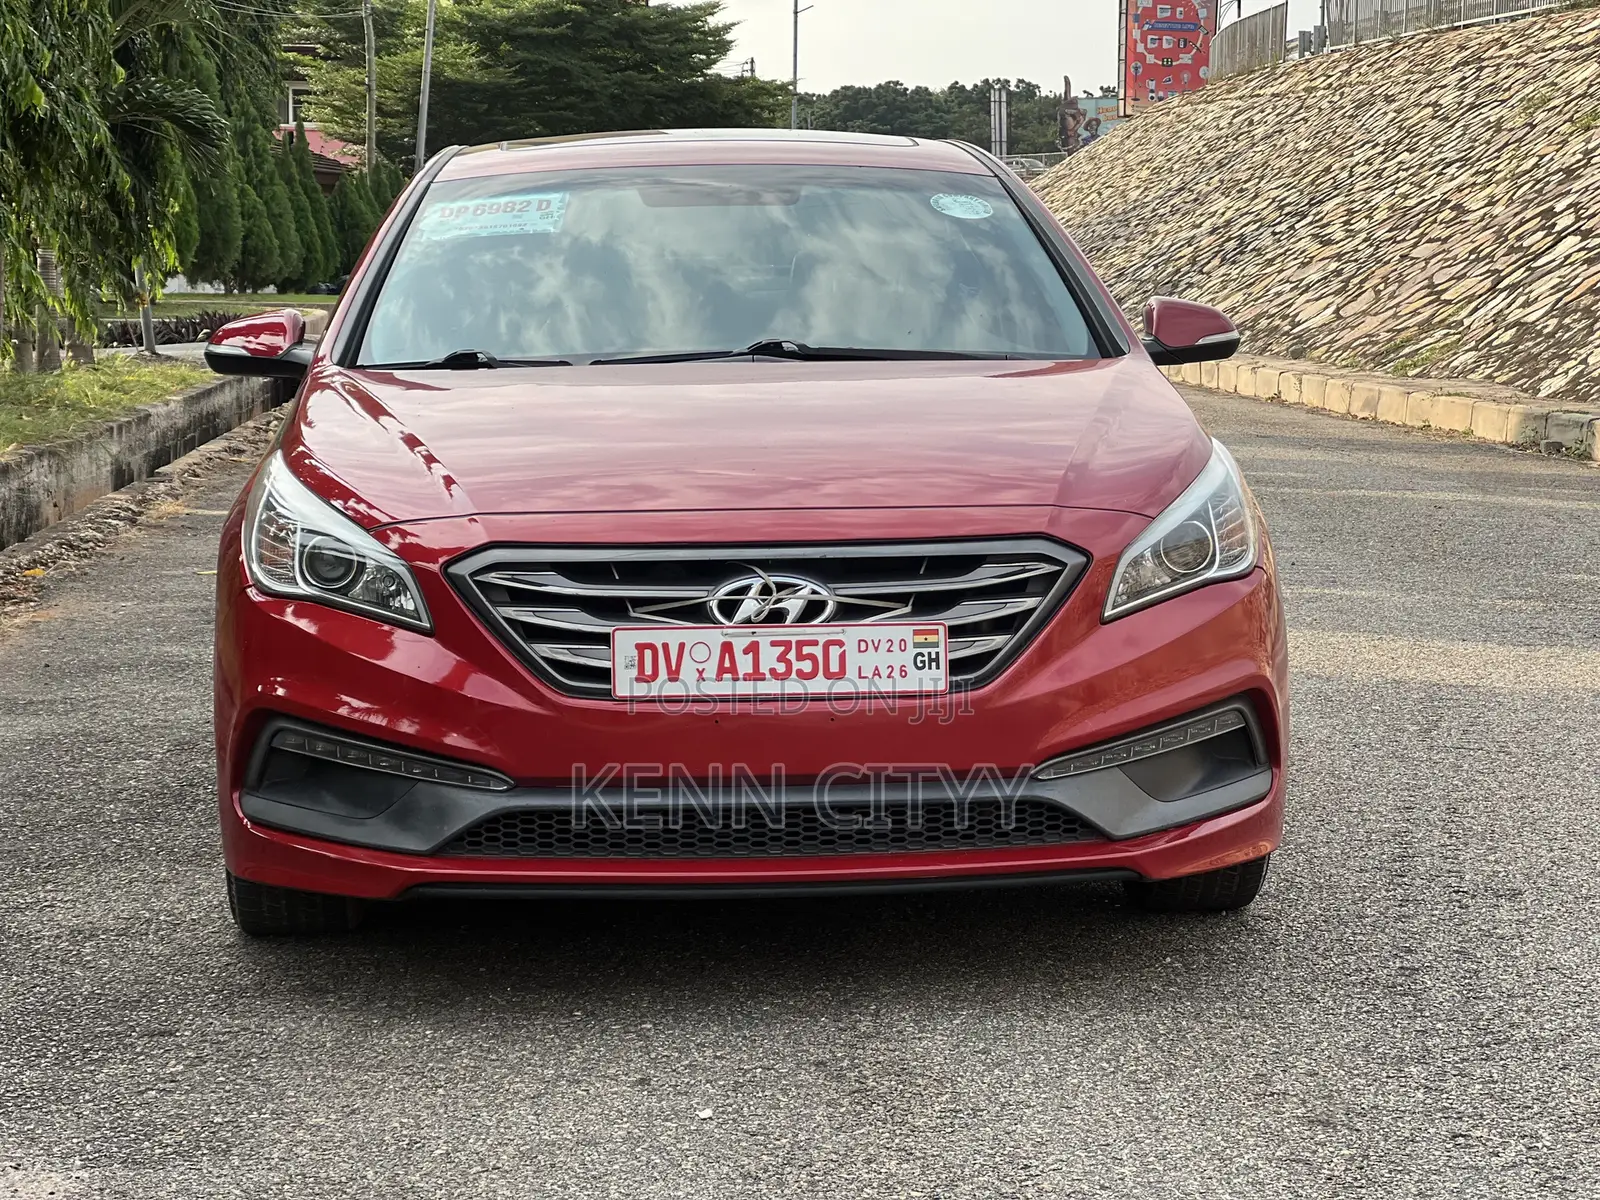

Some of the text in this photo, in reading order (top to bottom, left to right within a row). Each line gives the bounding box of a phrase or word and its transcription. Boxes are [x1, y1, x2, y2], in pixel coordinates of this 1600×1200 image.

[473, 199, 532, 217] 6982
[536, 199, 552, 212] D
[857, 637, 908, 654] DV20
[634, 641, 686, 683] DV
[715, 639, 847, 683] A1350
[913, 652, 941, 672] GH
[857, 664, 909, 680] LA26
